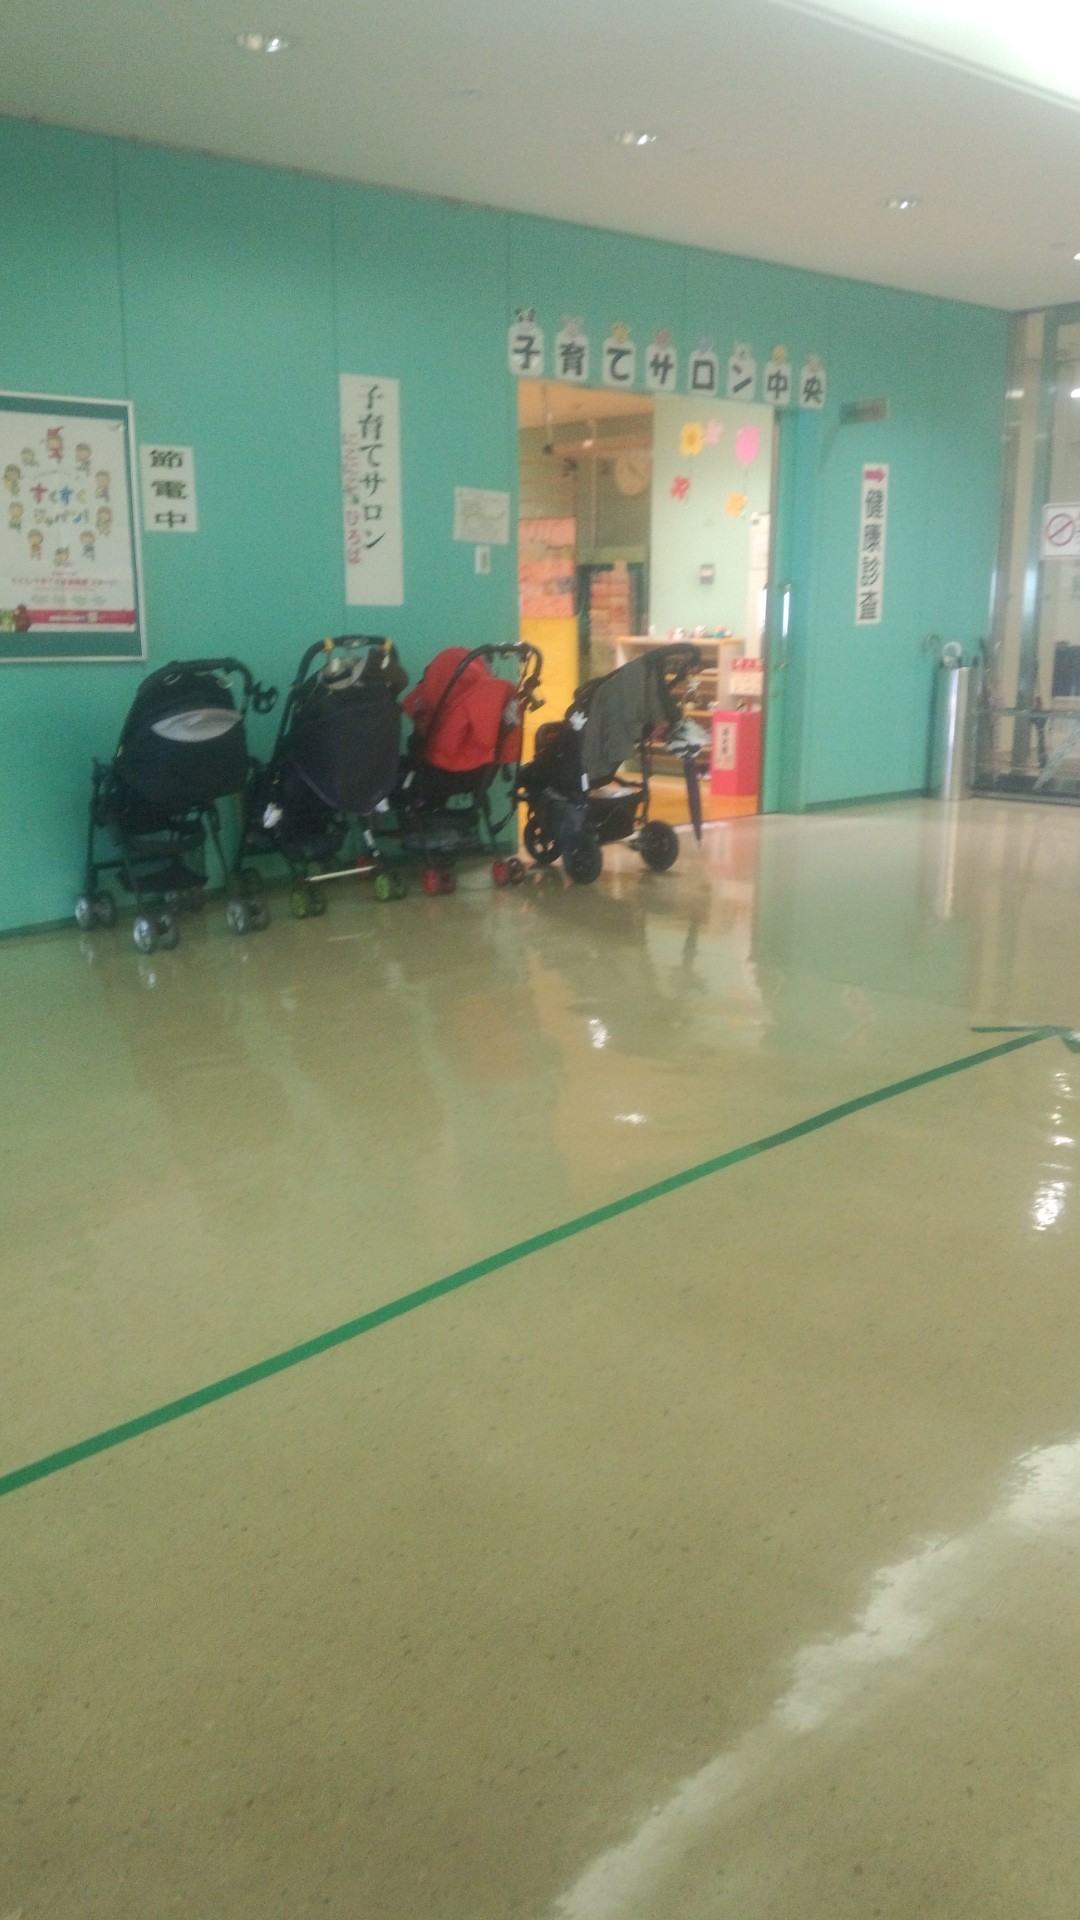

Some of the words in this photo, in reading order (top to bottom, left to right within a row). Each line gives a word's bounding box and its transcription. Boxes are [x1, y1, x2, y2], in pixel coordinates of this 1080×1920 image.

[513, 334, 823, 405] 子育てサロン中央
[149, 449, 188, 528] 節電中
[358, 384, 386, 549] 子育てサロン
